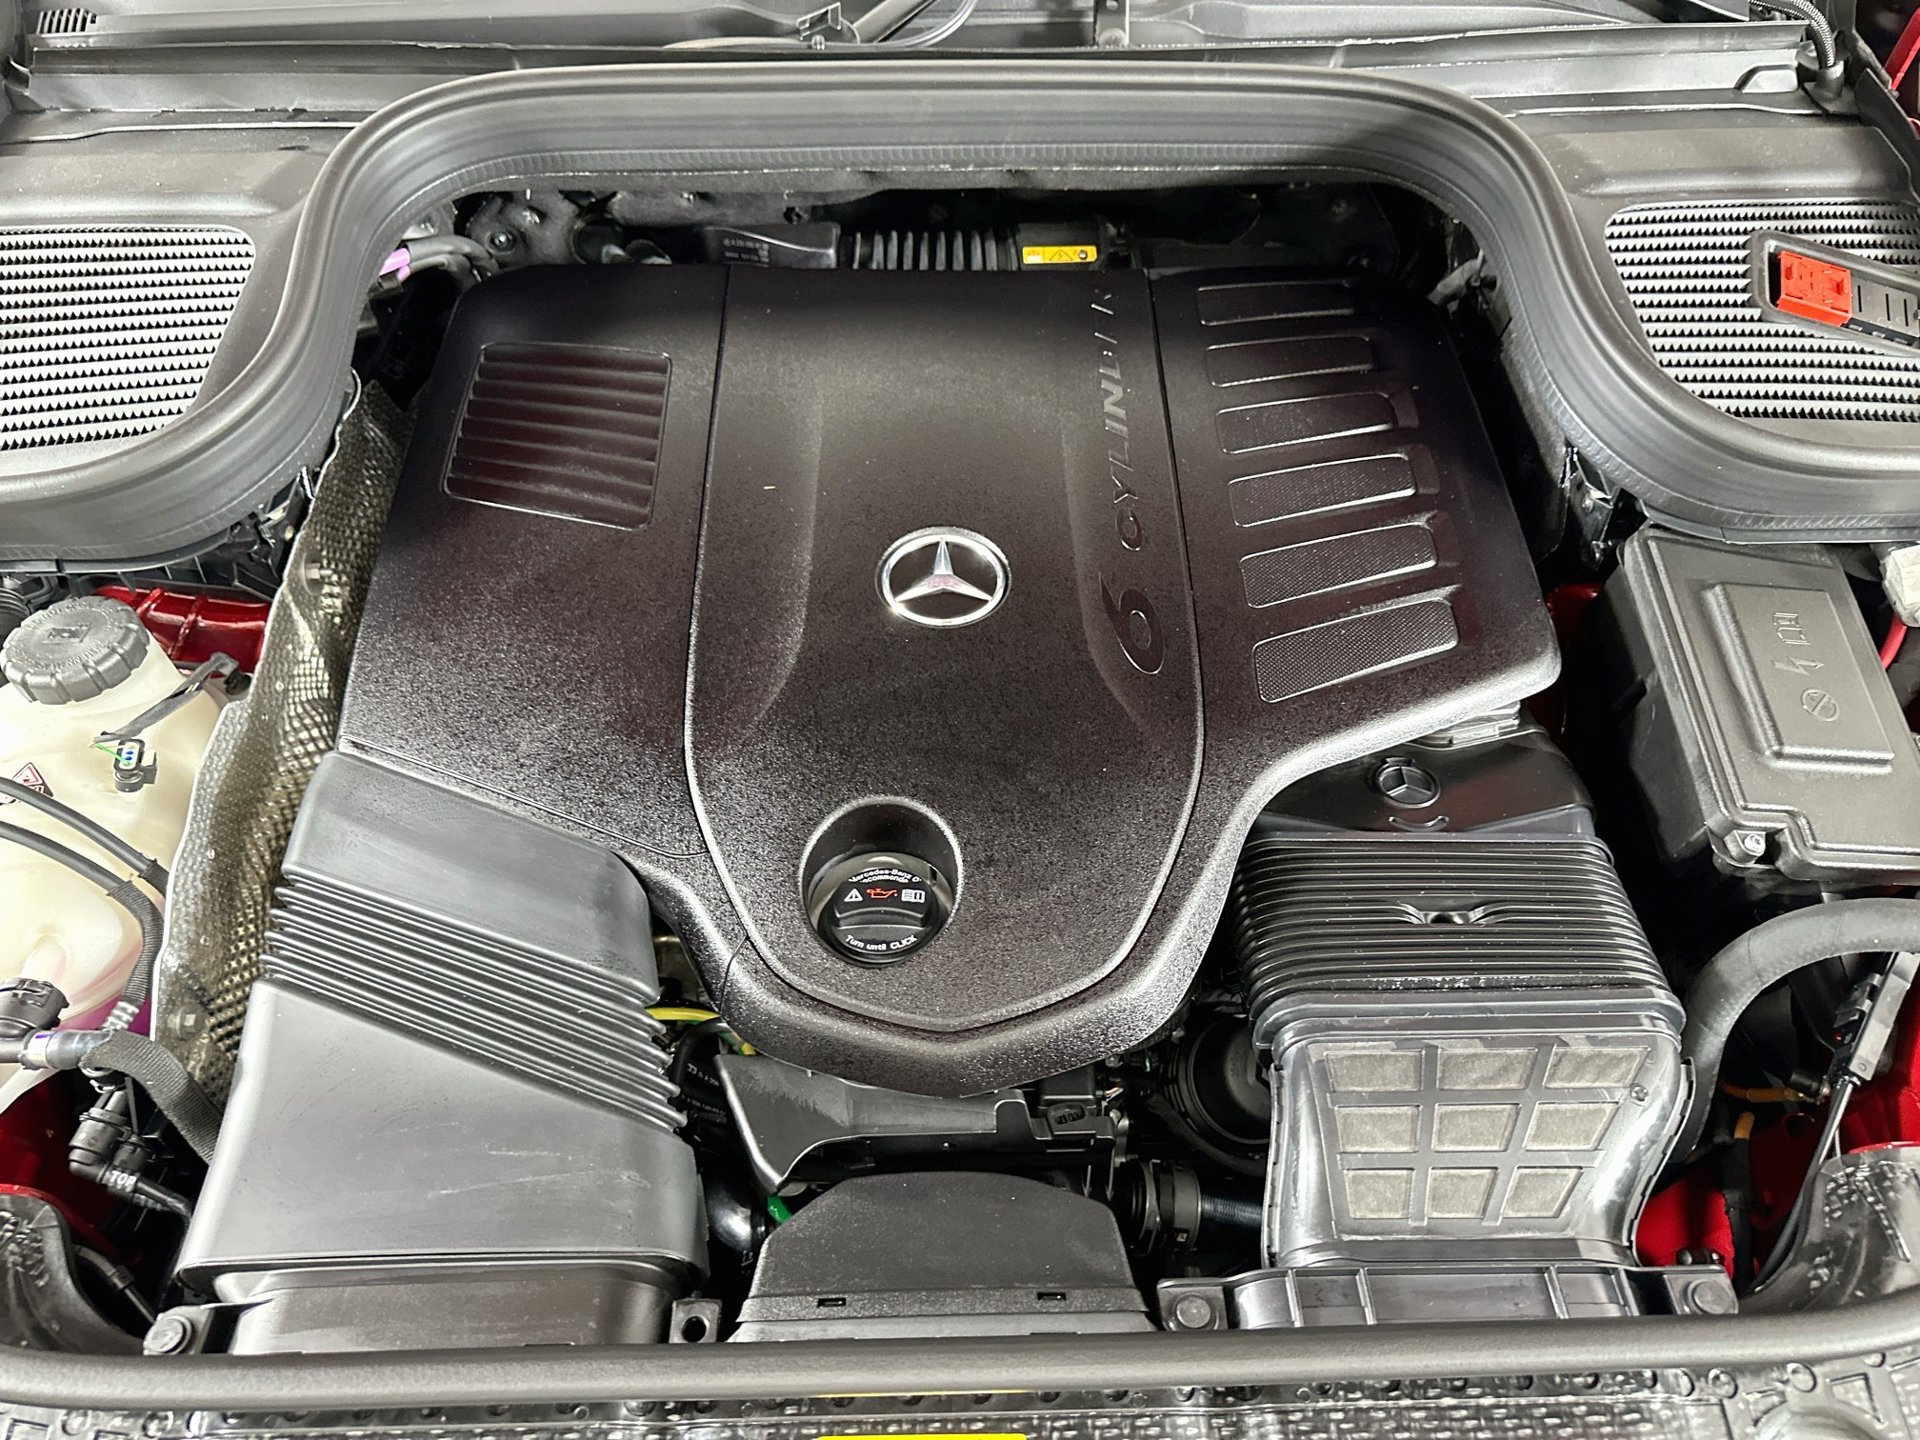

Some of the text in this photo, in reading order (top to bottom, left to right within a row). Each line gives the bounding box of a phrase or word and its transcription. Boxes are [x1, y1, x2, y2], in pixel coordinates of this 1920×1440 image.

[1090, 288, 1166, 675] 6 CYLINDR
[845, 934, 918, 951] Turn until CLICK
[109, 1170, 137, 1188] TOP
